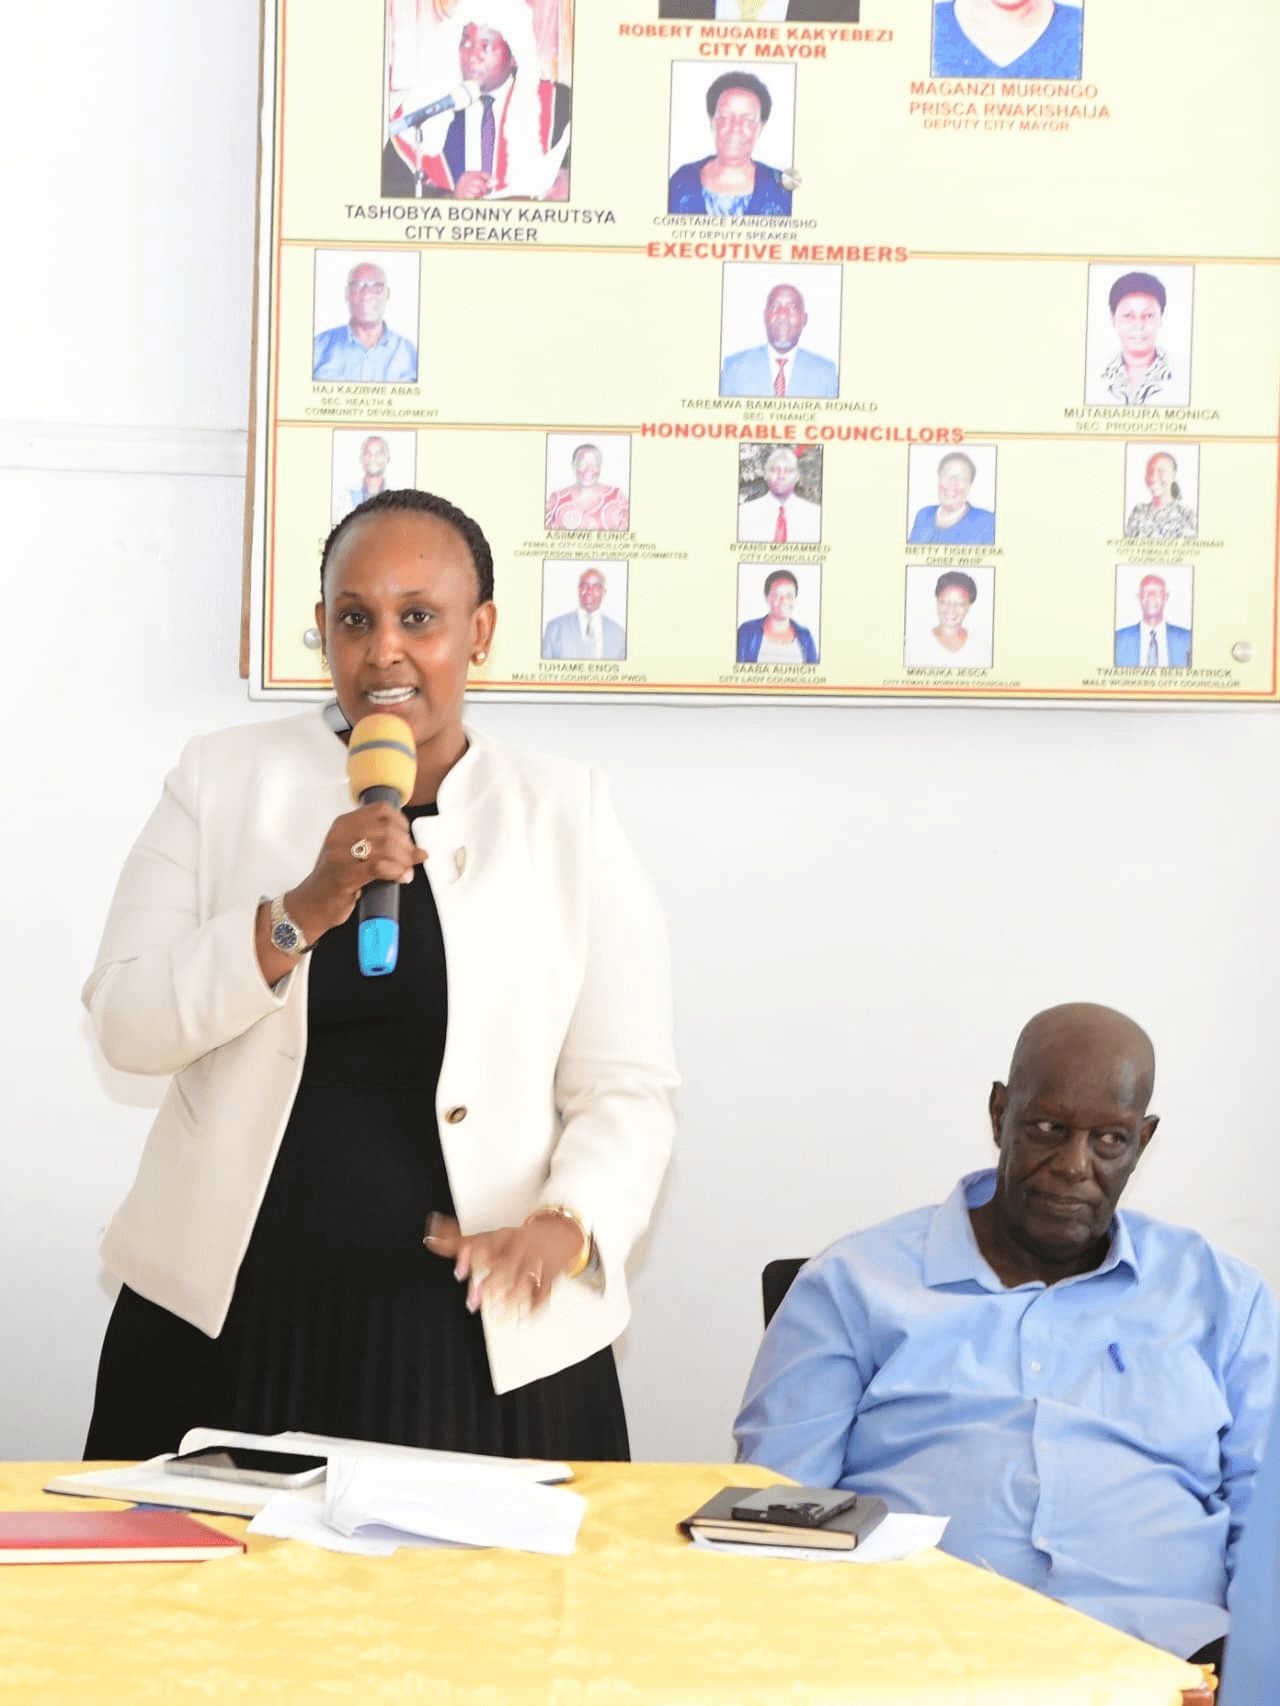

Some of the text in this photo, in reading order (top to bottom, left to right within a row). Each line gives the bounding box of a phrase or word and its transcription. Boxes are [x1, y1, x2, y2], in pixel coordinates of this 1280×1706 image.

[619, 23, 894, 42] ROBERT MUGABE KAKYEBEZI
[698, 42, 828, 59] CITY MAYOR
[909, 81, 1099, 99] MAGANZI MURONGO
[909, 102, 1111, 120] PRISCA RWAKISHAIJA
[923, 119, 1070, 133] DEPUTY CITY MAYOR
[344, 204, 616, 224] TASHOBYA BONNY KARUTSYA
[653, 216, 818, 230] CONSTANCE KAINOBWISHO
[405, 225, 538, 242] CITY SPEAKER
[671, 230, 798, 241] CITY DEPUTY SPEAKER
[646, 241, 909, 263] EXECUTIVE MEMBERS
[390, 386, 421, 397] ABAS
[345, 397, 385, 406] HEALTH
[387, 398, 393, 407] &
[680, 399, 742, 410] TAREMWA
[825, 401, 879, 413] RONALD
[304, 407, 439, 418] COMMUNITY DEVELOPMENT
[769, 412, 816, 422] FINANCE
[1164, 409, 1220, 421] MONICA
[640, 422, 966, 444] HONOURABLE COUNCILLORS
[1105, 422, 1188, 433] PRODUCTION
[596, 532, 638, 542] EUNICE
[523, 541, 554, 549] FEMALE
[558, 541, 576, 549] CITY
[577, 541, 631, 550] COUNCILLOR
[769, 544, 831, 553] MOHAMMED
[904, 546, 939, 556] BETTY
[739, 553, 827, 562] CITY COUNCILLOR
[926, 557, 954, 565] CHIEF
[537, 663, 620, 674] TUHAME ENOS
[511, 673, 536, 682] MALE
[538, 673, 559, 682] CITY
[560, 673, 619, 683] COUNCILLOR
[719, 675, 739, 684] CITY
[766, 676, 827, 685] COUNCILLOR
